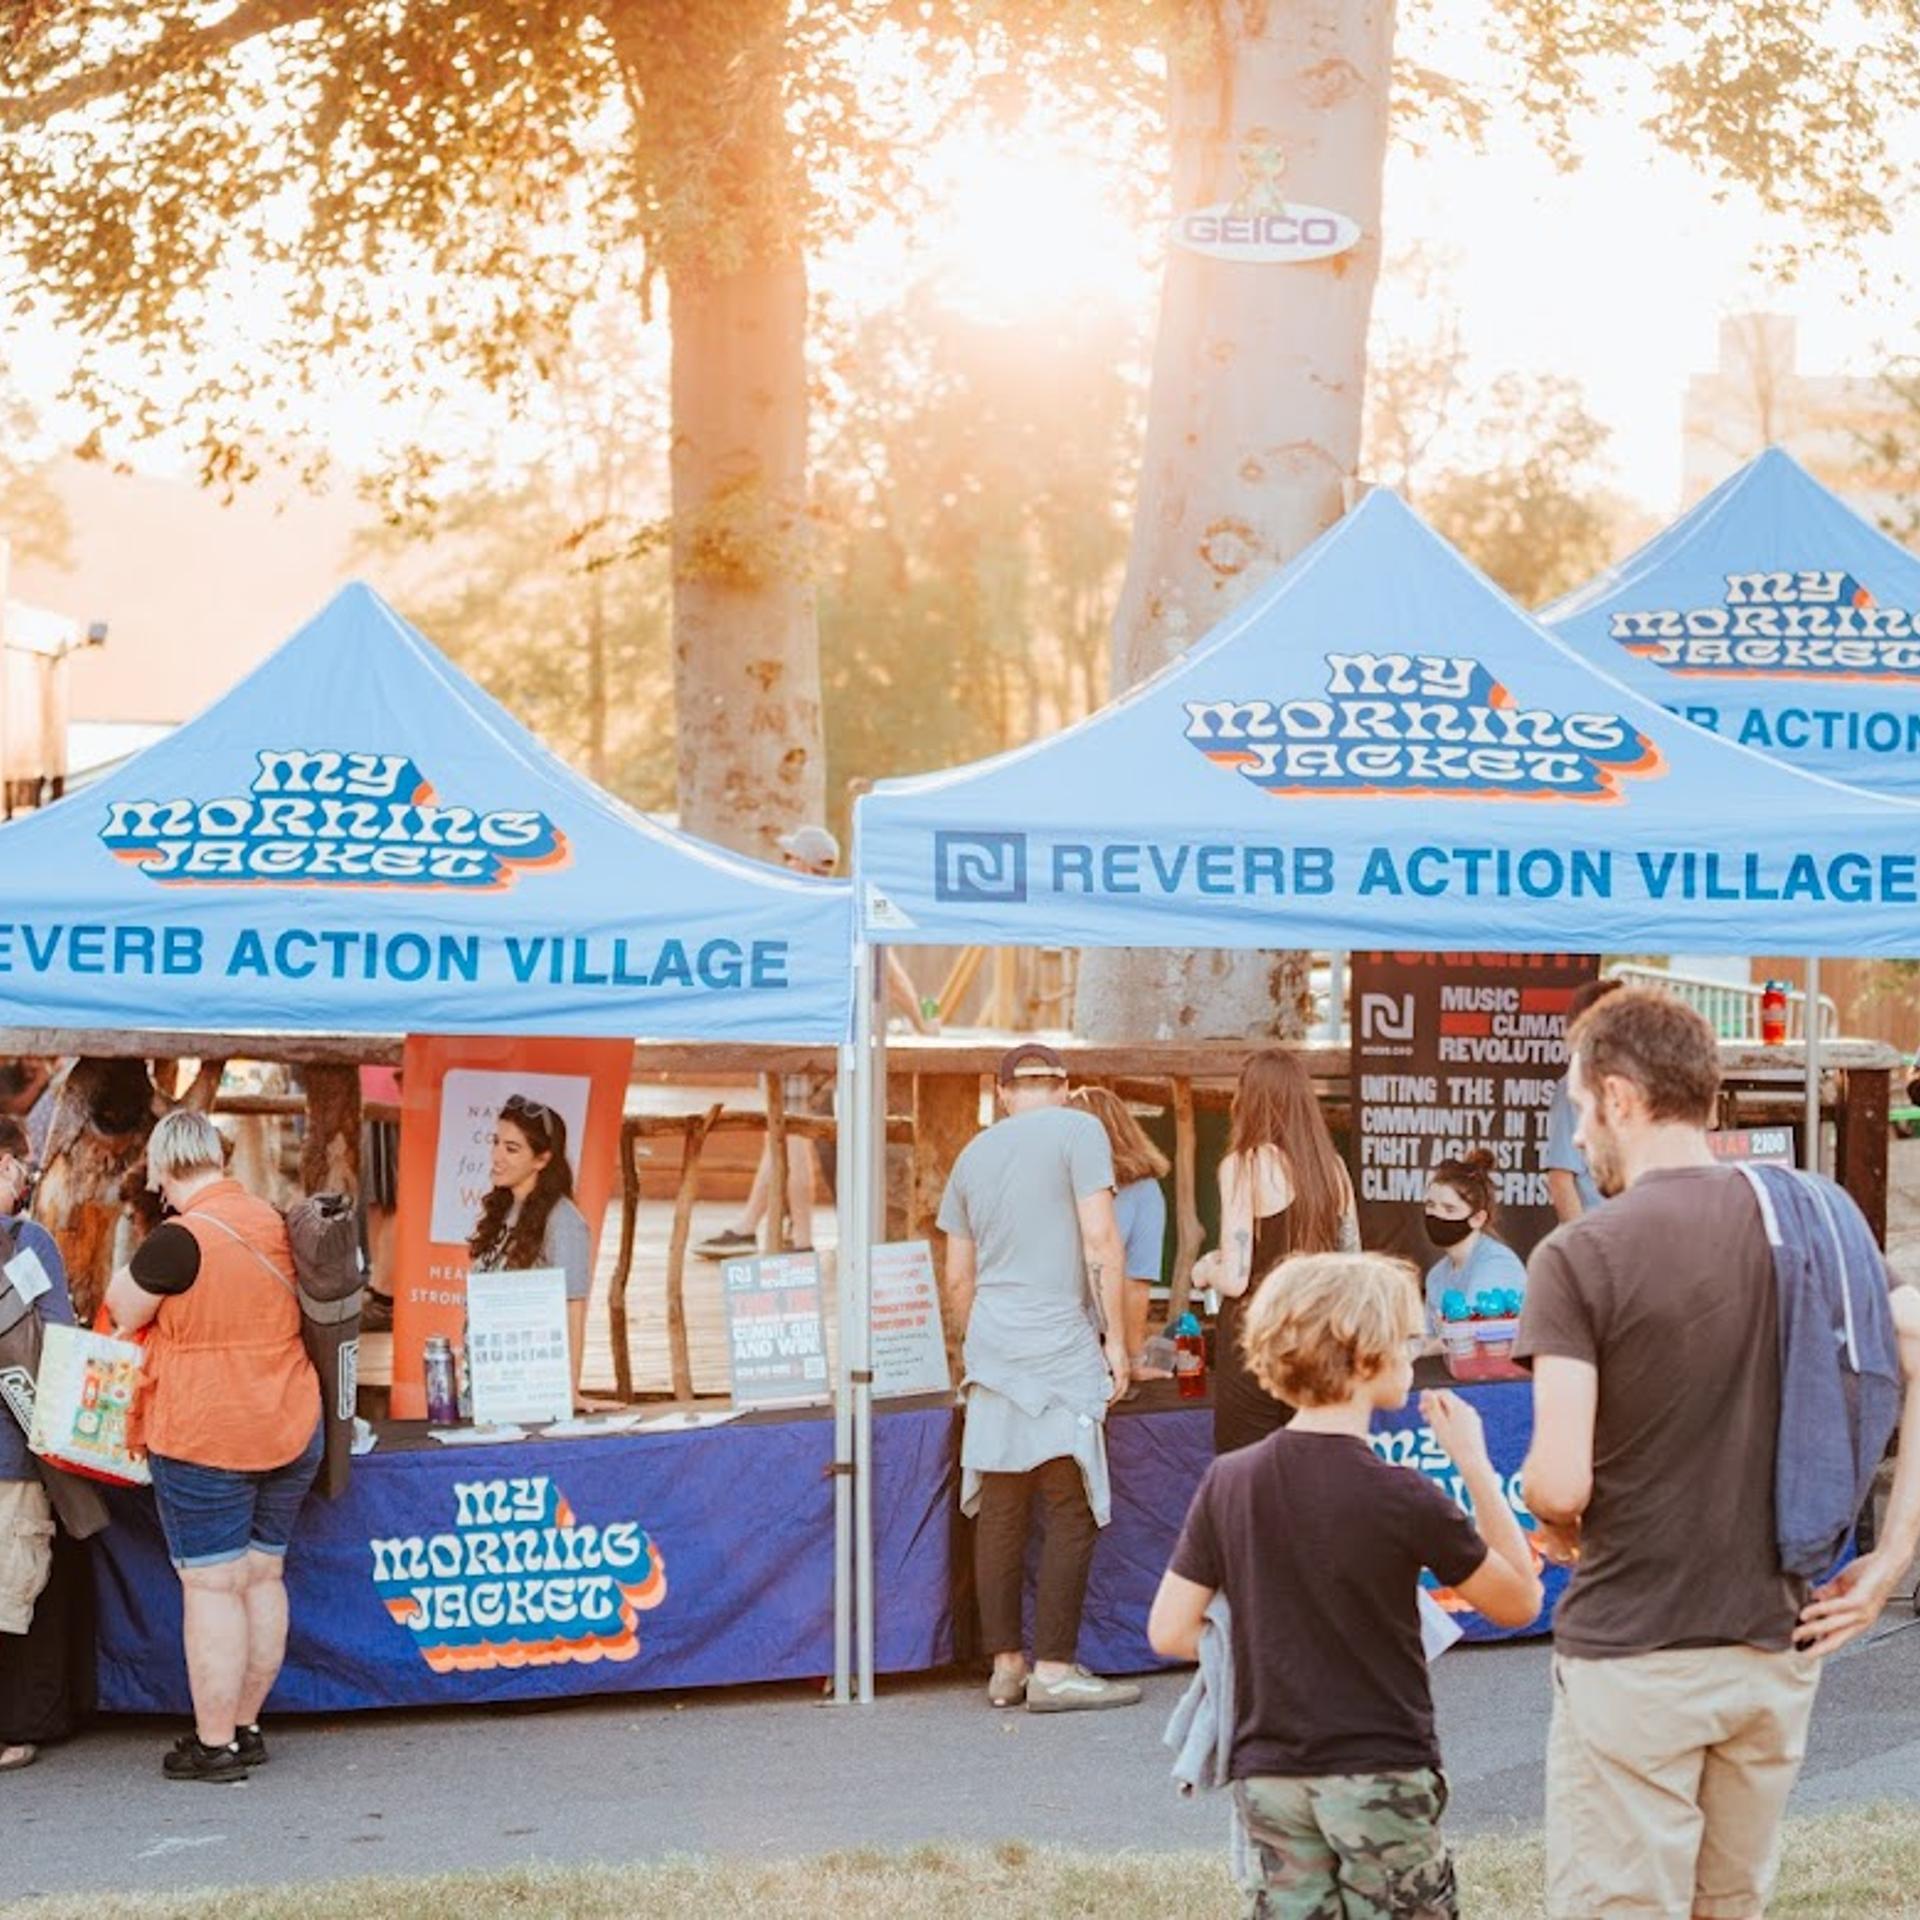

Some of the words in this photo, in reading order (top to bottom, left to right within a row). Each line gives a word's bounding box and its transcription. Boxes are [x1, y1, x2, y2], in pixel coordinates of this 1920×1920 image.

[1184, 216, 1338, 246] GEICO
[1609, 606, 1920, 638] MORNIN
[1183, 700, 1625, 749] MORNING
[1237, 743, 1585, 783] JACKET
[100, 798, 542, 847] MORNING
[141, 840, 489, 879] JACKET
[1051, 844, 1336, 896] REVERB
[1357, 845, 1612, 899] ACTION
[1636, 851, 1917, 903] VILLAGE
[225, 928, 480, 982] ACTION
[504, 936, 789, 989] VILLAGE
[1440, 986, 1520, 1012] MUSIC
[1492, 1013, 1569, 1039] CLIMAT
[1438, 1036, 1571, 1065] REVOLUTIO
[1361, 1074, 1437, 1103] UNITING
[1447, 1076, 1494, 1105] THE
[1503, 1078, 1557, 1107] MUS
[1361, 1106, 1497, 1138] COMMUNITY
[1504, 1109, 1526, 1139] IN
[1361, 1135, 1421, 1168] FIGHT
[409, 1287, 466, 1306] STRON
[369, 1521, 641, 1582] MORNING
[406, 1574, 614, 1632] JACKET
